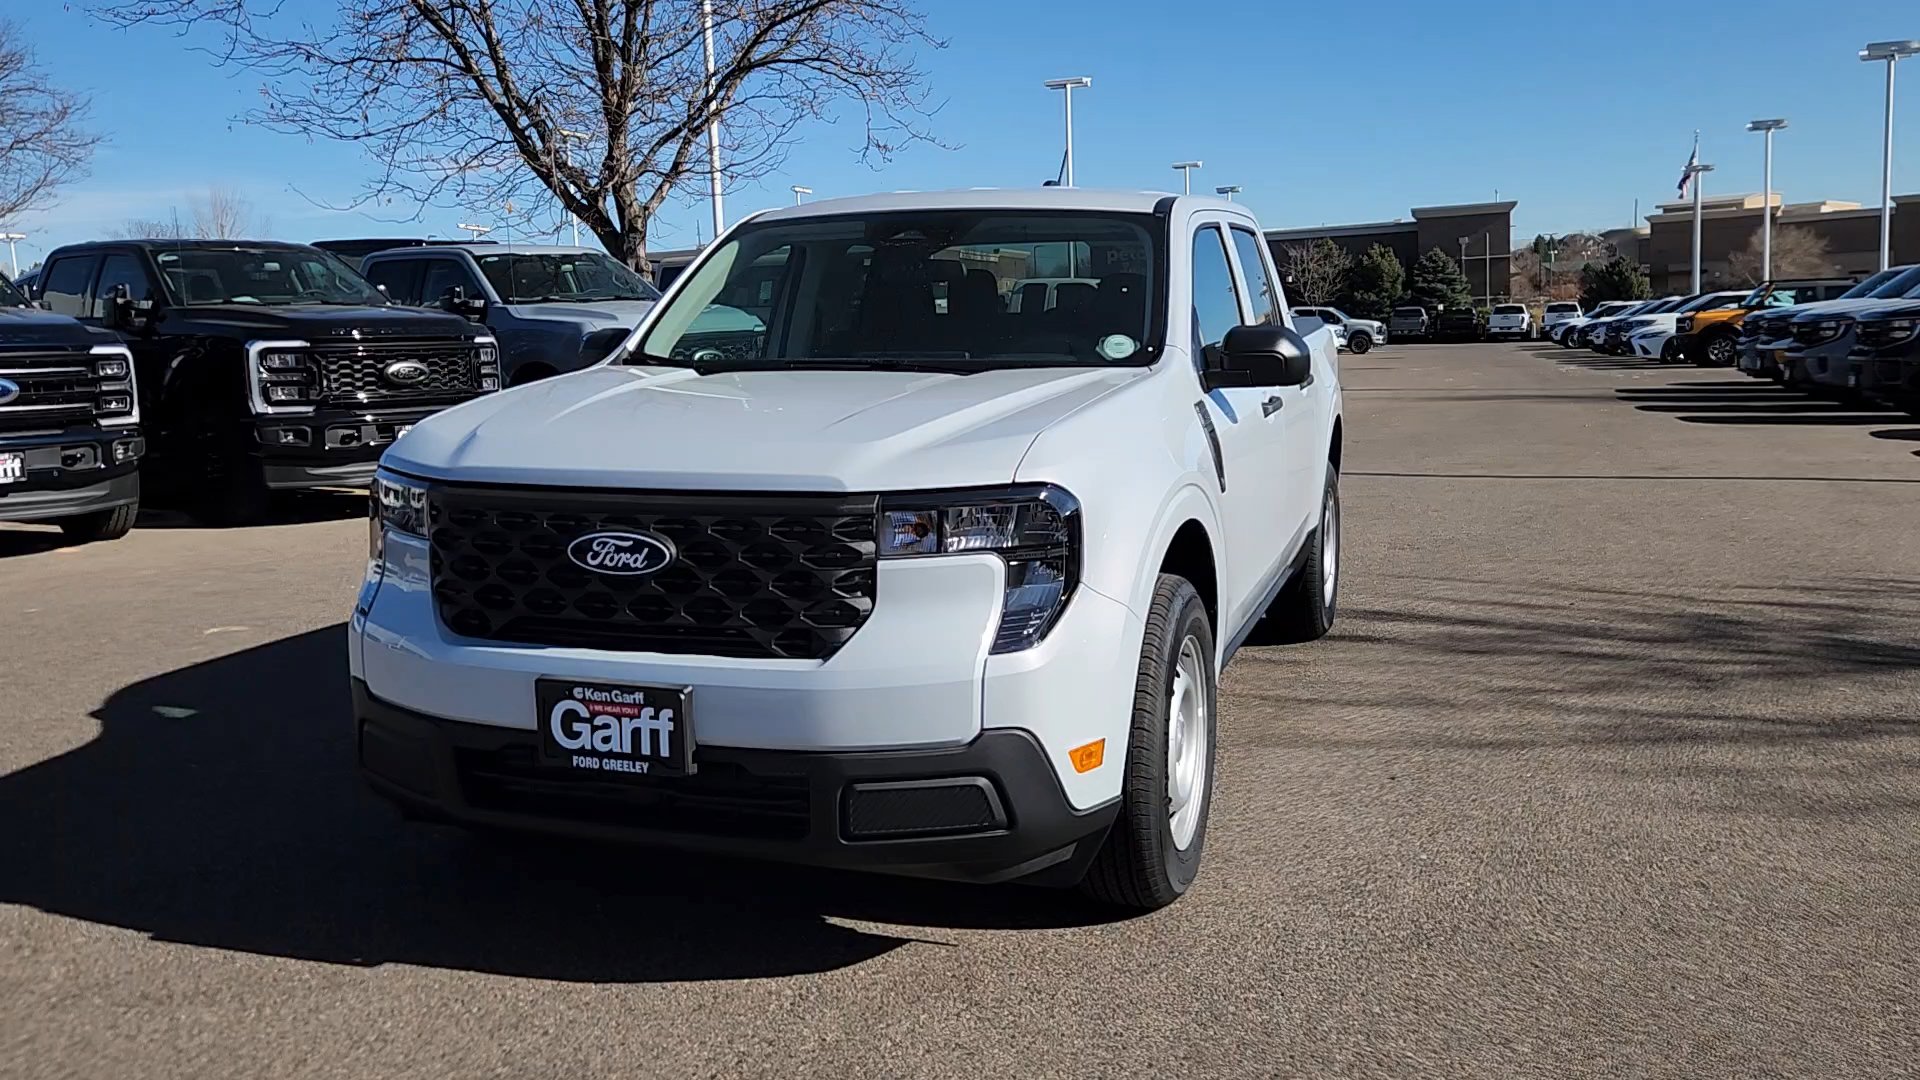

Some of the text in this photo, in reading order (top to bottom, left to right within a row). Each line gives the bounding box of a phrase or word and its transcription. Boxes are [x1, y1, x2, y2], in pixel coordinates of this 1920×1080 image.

[587, 538, 649, 569] Ford
[584, 687, 645, 704] Ken Garff
[604, 705, 621, 714] HEAR
[621, 707, 634, 715] YOU
[551, 699, 674, 757] Garff
[572, 755, 649, 774] FORD GREELEY
